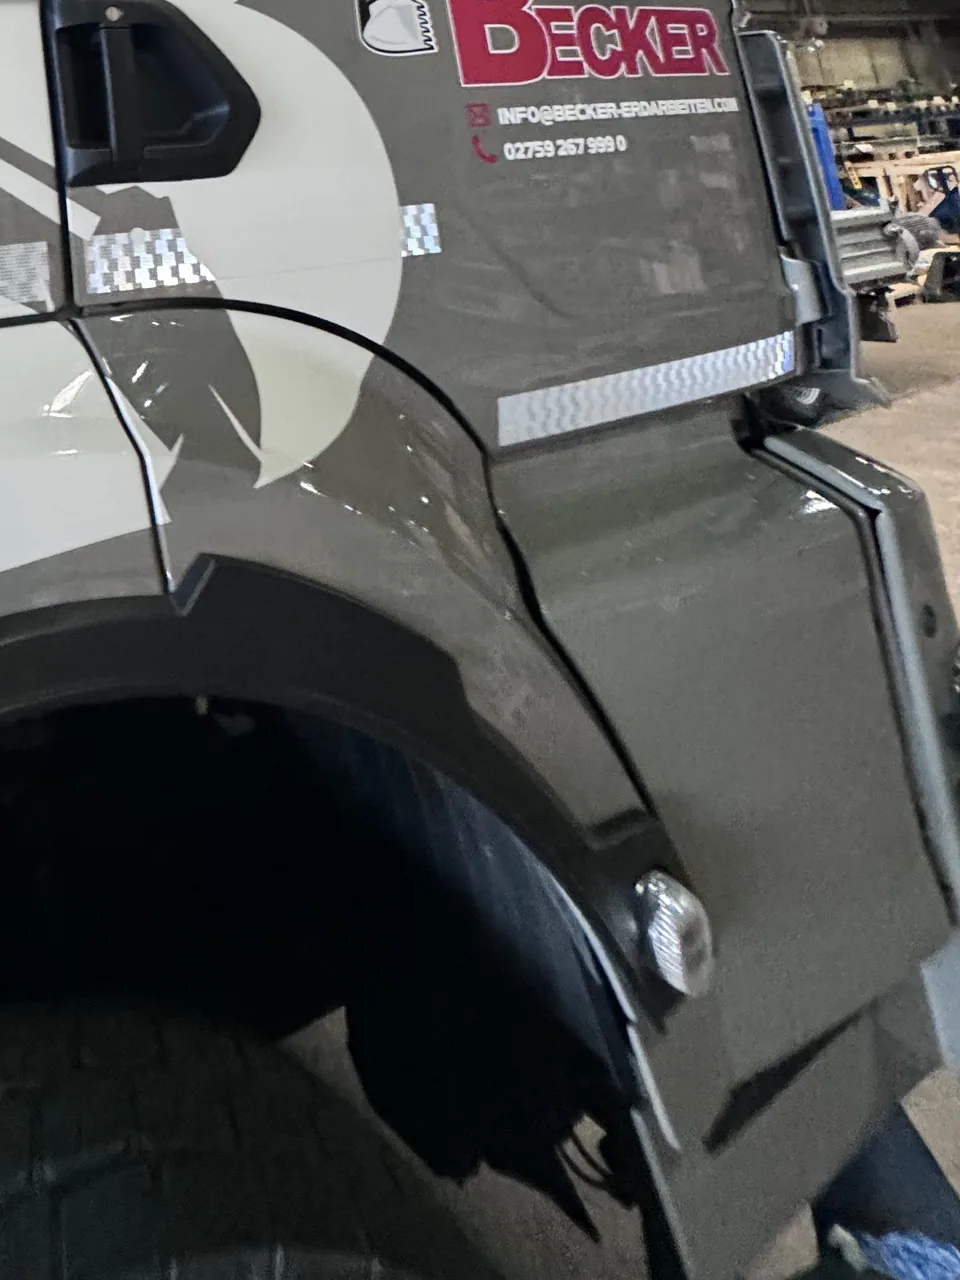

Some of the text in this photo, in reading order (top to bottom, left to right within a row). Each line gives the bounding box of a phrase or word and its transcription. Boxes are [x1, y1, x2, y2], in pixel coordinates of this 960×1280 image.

[503, 140, 555, 160] 02759
[586, 136, 615, 154] 999
[615, 134, 627, 152] 0
